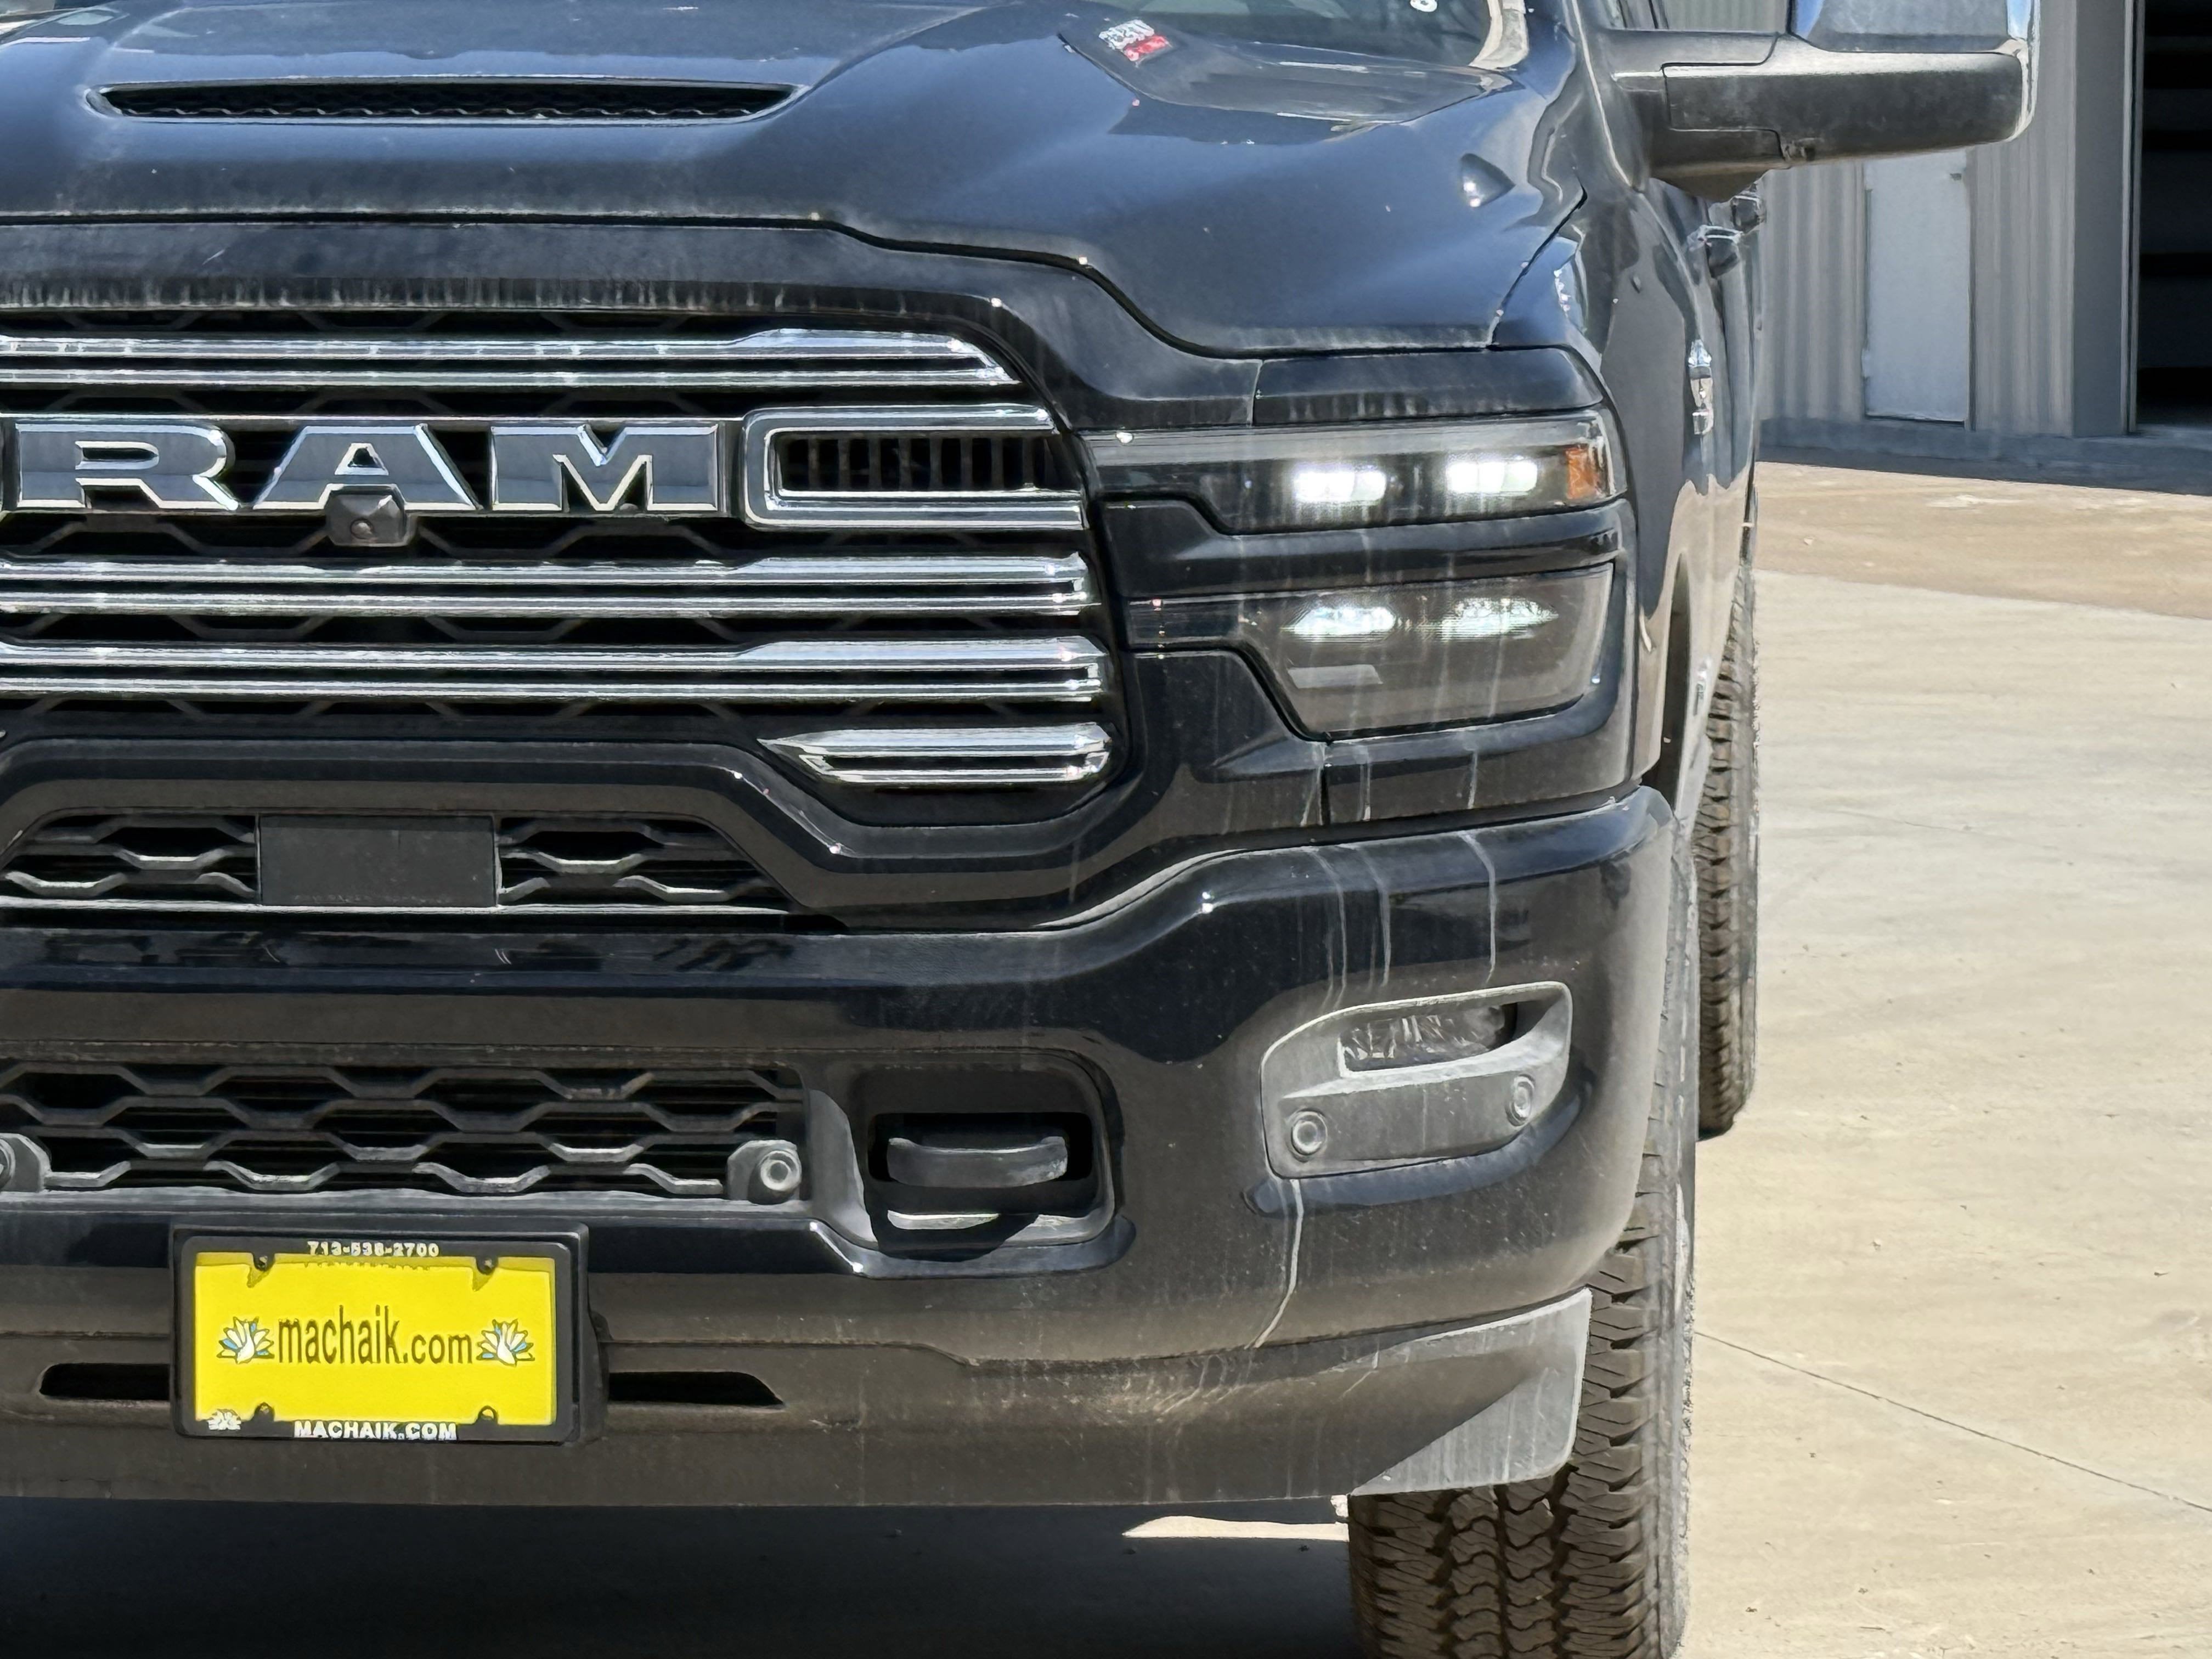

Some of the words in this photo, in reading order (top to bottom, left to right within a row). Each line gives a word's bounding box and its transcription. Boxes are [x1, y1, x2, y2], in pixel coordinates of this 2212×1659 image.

[15, 423, 719, 511] RAM
[278, 1306, 473, 1364] machaik.com
[294, 1420, 458, 1441] MACHAIK.COM
